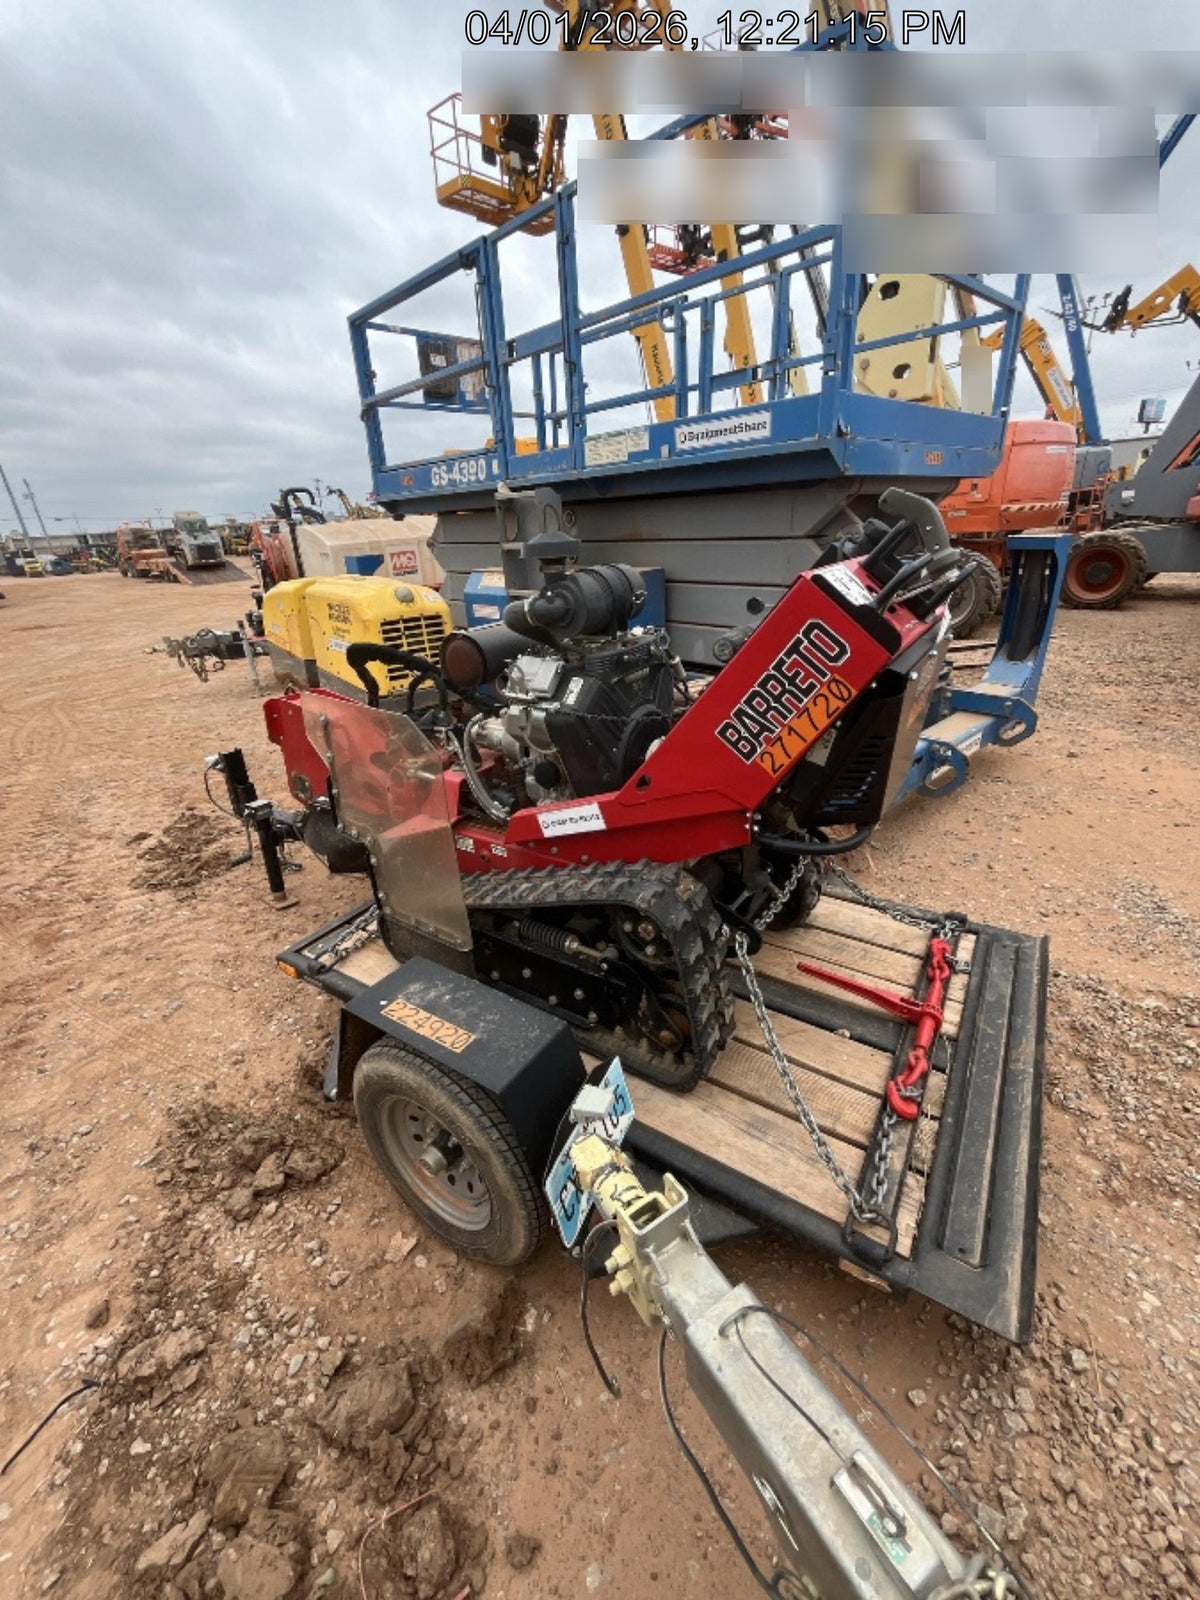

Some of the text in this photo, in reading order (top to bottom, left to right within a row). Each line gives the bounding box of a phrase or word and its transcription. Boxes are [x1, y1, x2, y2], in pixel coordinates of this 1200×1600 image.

[687, 419, 768, 443] EquipmentShare
[431, 459, 487, 486] GS-4390
[714, 619, 851, 765] BARRETO
[760, 677, 853, 775] 271720
[382, 1001, 472, 1050] 224920
